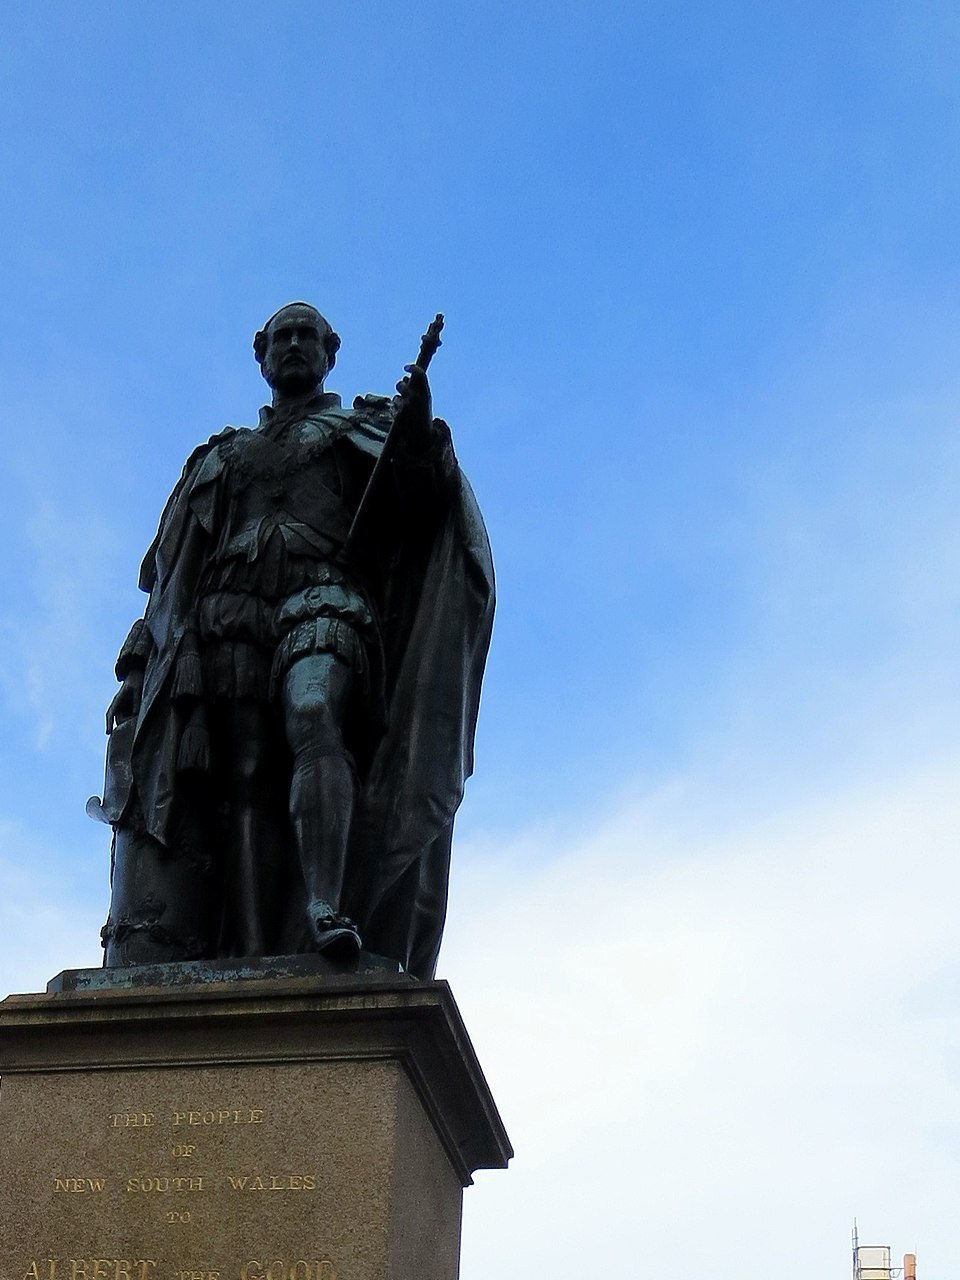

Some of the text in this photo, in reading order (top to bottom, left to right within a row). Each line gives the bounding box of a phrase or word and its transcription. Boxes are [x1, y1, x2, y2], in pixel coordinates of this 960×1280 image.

[108, 1109, 264, 1128] THE PEOPLE
[172, 1145, 195, 1157] OF
[54, 1174, 317, 1194] NEW SOUTH WALES
[166, 1211, 191, 1224] TO
